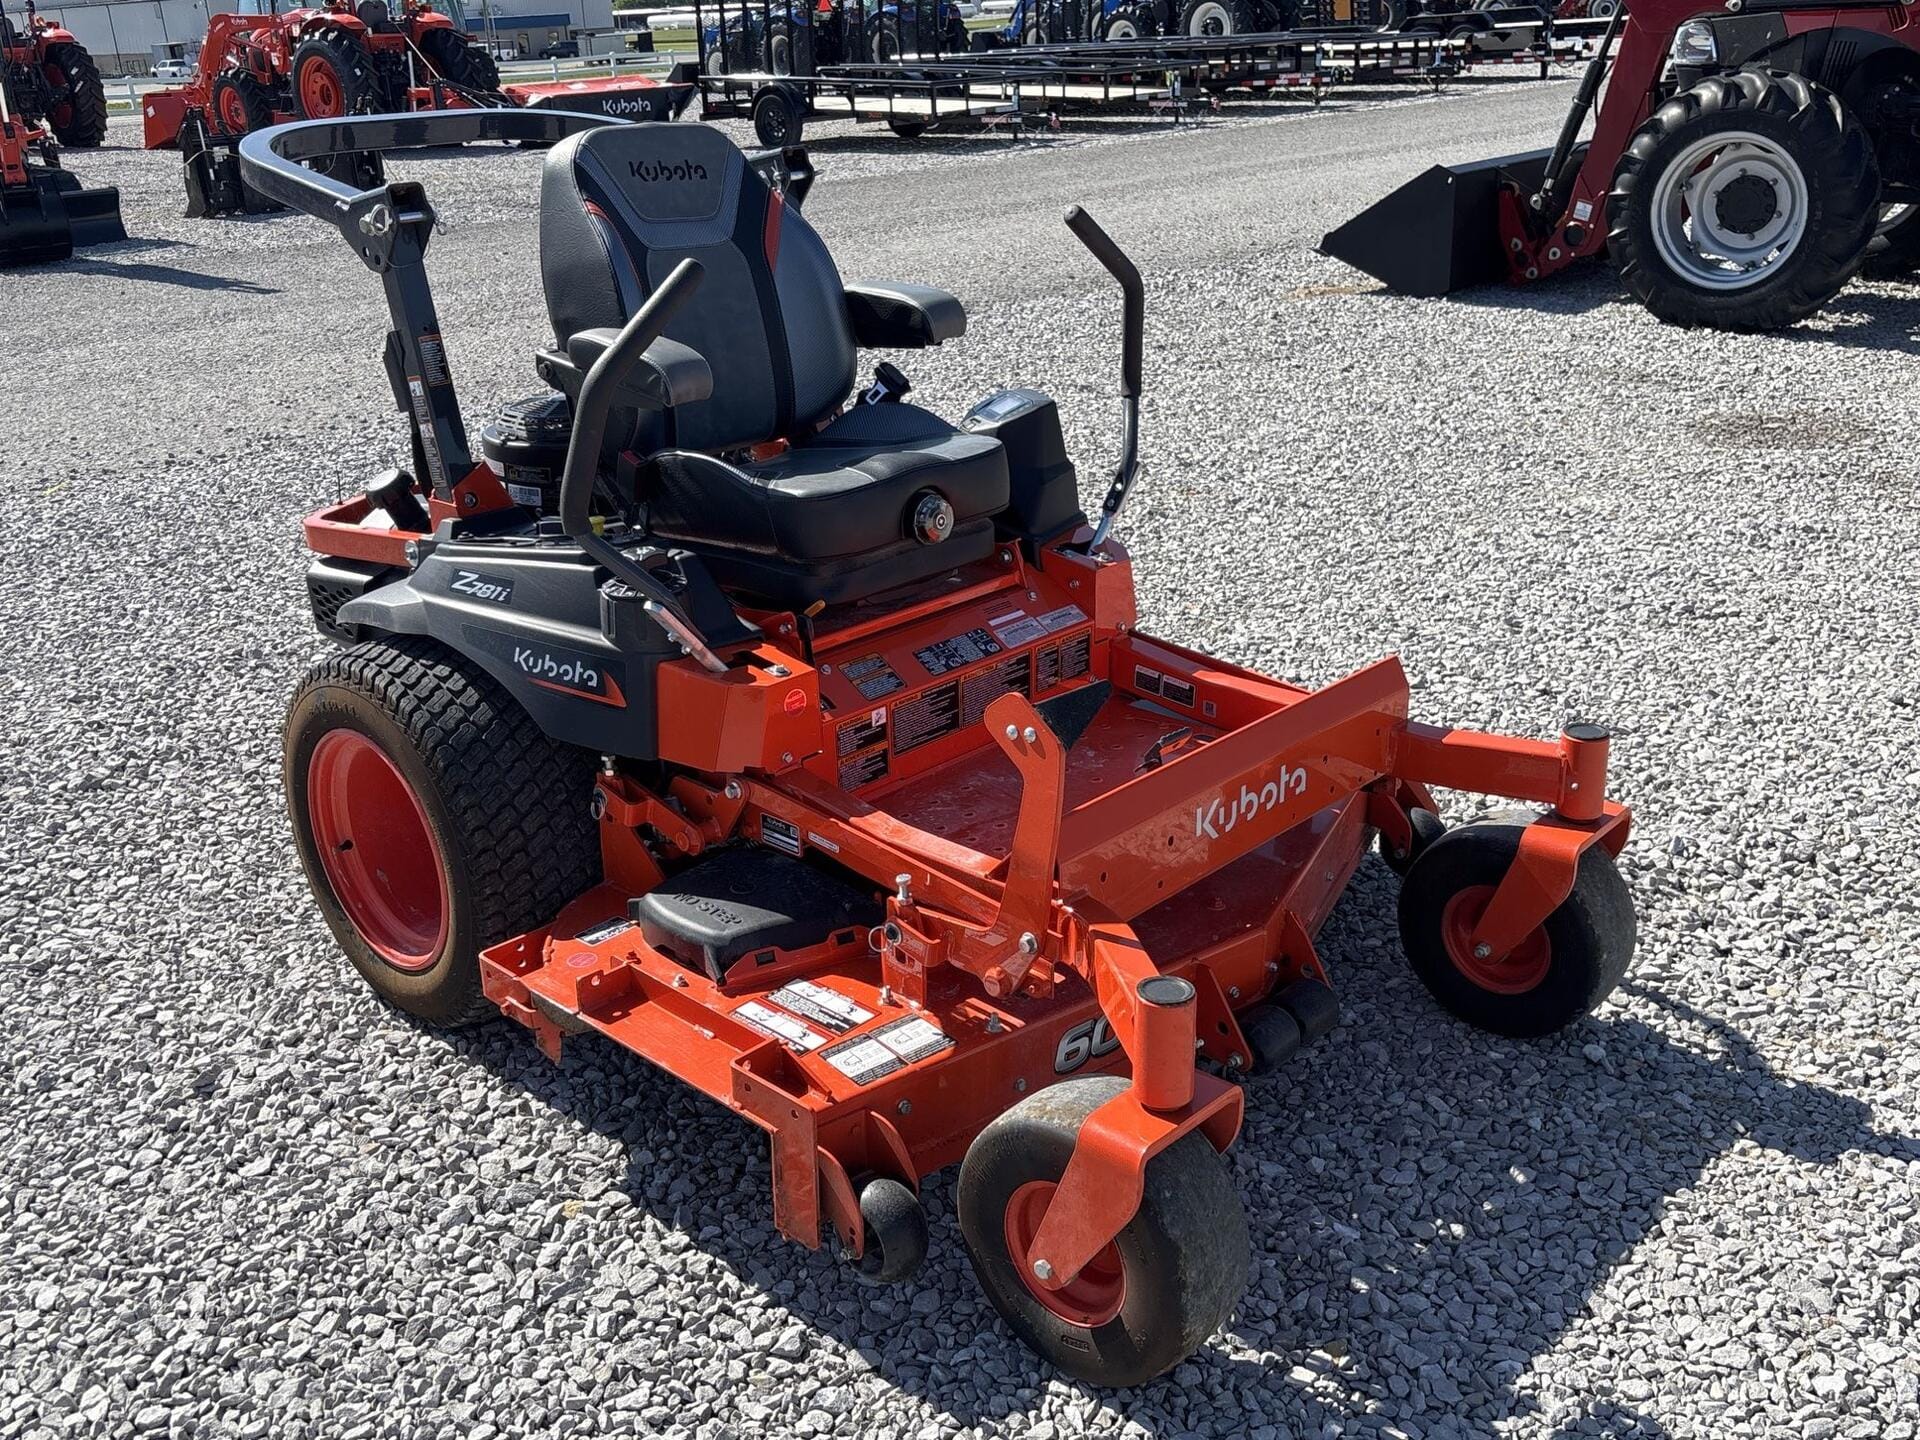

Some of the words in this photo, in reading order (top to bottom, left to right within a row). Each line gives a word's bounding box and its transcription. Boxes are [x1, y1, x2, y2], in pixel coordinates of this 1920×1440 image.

[602, 97, 652, 115] Kubota
[629, 159, 708, 182] Kubota
[451, 571, 511, 602] Z781i
[513, 647, 598, 687] Kubota
[1195, 764, 1307, 840] Kubota
[673, 893, 700, 905] NO
[700, 902, 742, 924] STEP
